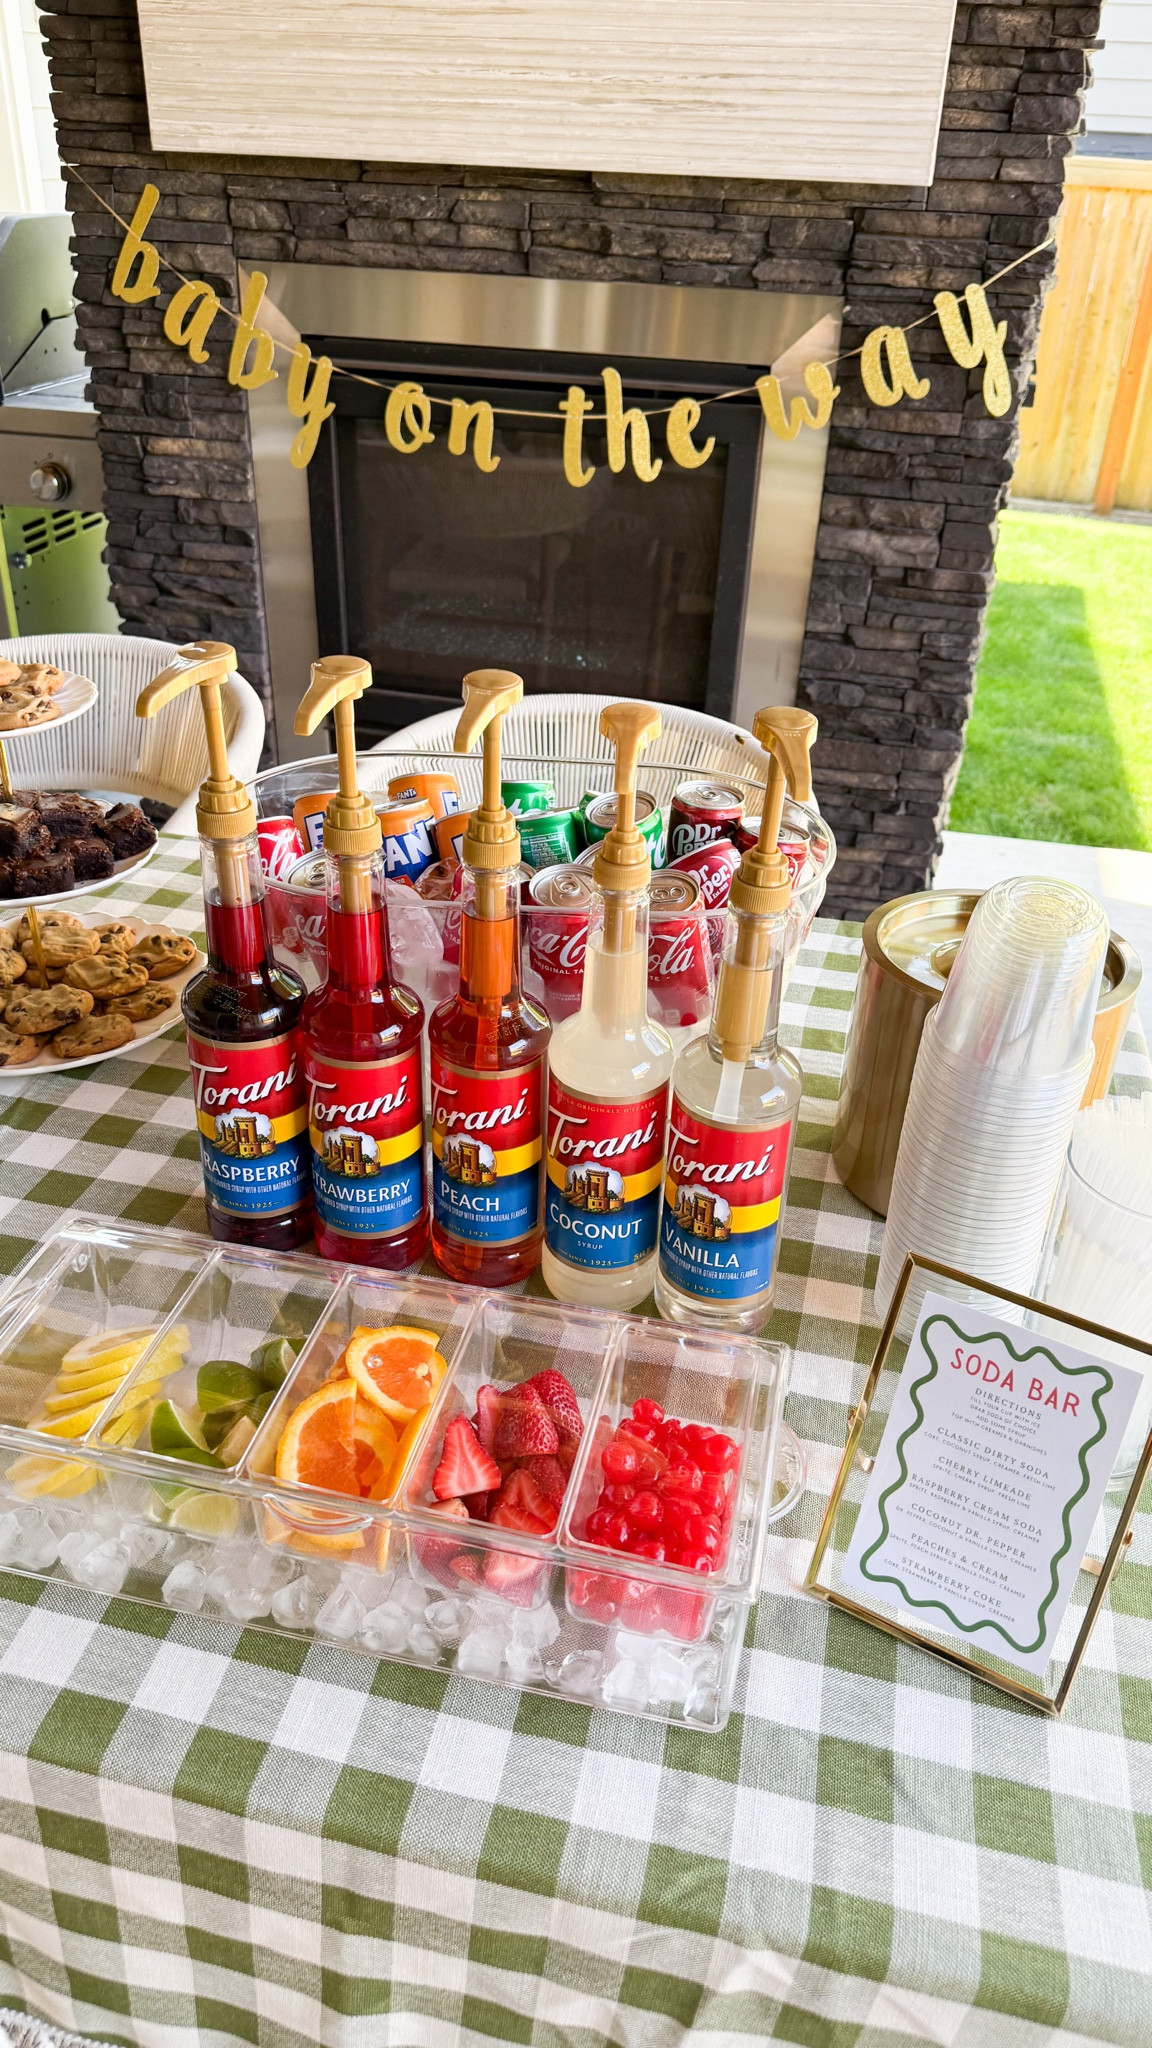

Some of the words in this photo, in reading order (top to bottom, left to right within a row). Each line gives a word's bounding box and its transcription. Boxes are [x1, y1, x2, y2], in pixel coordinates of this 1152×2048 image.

[112, 184, 335, 469] baby
[385, 382, 500, 472] on
[559, 367, 716, 487] the
[755, 284, 1012, 440] way
[695, 823, 721, 839] Dr
[189, 1052, 298, 1110] Torani
[305, 1076, 408, 1123] Torani
[431, 1083, 529, 1131] Torani
[549, 1105, 658, 1159] Torani
[666, 1122, 774, 1183] Torani
[203, 1151, 299, 1181] RASPBERRY
[441, 1180, 499, 1212] PEACH
[469, 1229, 489, 1237] 1925
[550, 1203, 642, 1240] COCONUT
[577, 1240, 603, 1250] SYRUP
[666, 1221, 739, 1268] VANILLA
[568, 1254, 587, 1263] SINCE
[703, 1269, 717, 1279] OTHER
[719, 1272, 739, 1280] NATURAL
[694, 1284, 714, 1293] 1925
[949, 1347, 1014, 1392] SODA
[1026, 1376, 1080, 1417] BAR
[974, 1387, 1042, 1420] DIRECTIONS
[951, 1411, 963, 1420] TOP
[963, 1417, 980, 1427] WITH
[980, 1424, 1007, 1439] CREAMER
[1013, 1438, 1047, 1456] GARNISHES
[969, 1403, 985, 1414] GRAB
[985, 1410, 1003, 1421] SODA
[1003, 1417, 1013, 1425] OF
[1012, 1421, 1037, 1435] CHOICE
[975, 1414, 989, 1423] ADD
[990, 1419, 1006, 1431] SOME
[1007, 1427, 1026, 1438] SYRUP
[936, 1426, 981, 1450] CLASSIC
[983, 1445, 1017, 1465] DIRTY
[1019, 1461, 1049, 1479] SODA
[941, 1438, 971, 1455] COCONUT
[1022, 1473, 1041, 1485] FRESH
[937, 1455, 980, 1478] CHERRY
[982, 1474, 1031, 1501] LIMEADE
[953, 1472, 976, 1485] CHERRY
[997, 1491, 1016, 1502] FRESH
[911, 1472, 970, 1504] RASPBERRY
[972, 1500, 1010, 1522] CREAM
[1012, 1518, 1042, 1536] SODA
[929, 1491, 961, 1508] RASPBERRY
[1012, 1528, 1040, 1543] CREAMER
[910, 1502, 962, 1530] COCONUT
[964, 1526, 982, 1540] DR.
[986, 1535, 1026, 1559] PEPPER
[927, 1520, 958, 1537] COCONUT
[1009, 1557, 1037, 1572] CREAMER
[909, 1542, 929, 1554] PEACH
[998, 1583, 1026, 1599] CREAMER
[910, 1532, 957, 1559] PEACHES
[959, 1554, 968, 1564] &
[971, 1560, 1008, 1582] CREAM
[901, 1556, 970, 1593] STRAWBERRY
[972, 1589, 1002, 1608] COKE
[901, 1566, 937, 1586] STRAWBERRY
[988, 1606, 1015, 1622] CREAMER
